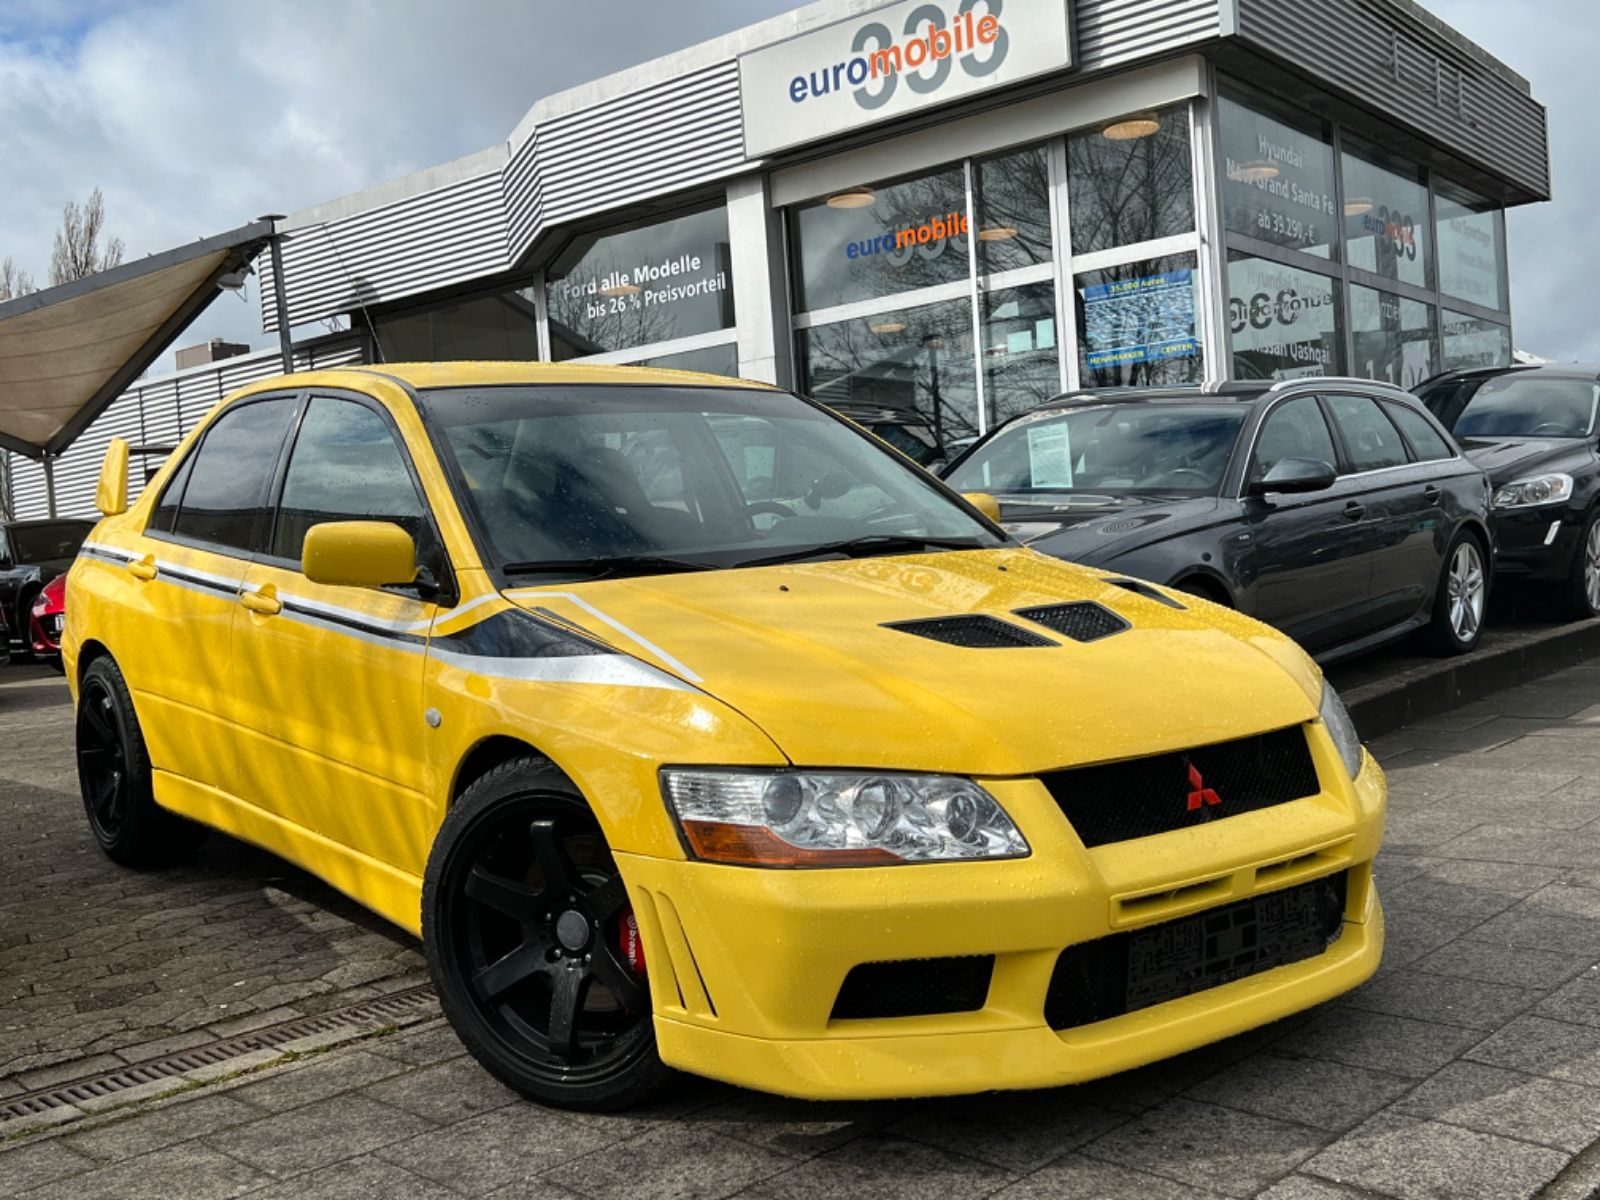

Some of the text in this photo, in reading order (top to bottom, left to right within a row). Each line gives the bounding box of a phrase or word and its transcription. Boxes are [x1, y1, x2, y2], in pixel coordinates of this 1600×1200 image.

[789, 11, 1000, 103] euromobile
[1257, 134, 1303, 168] Hyundai
[1258, 209, 1271, 229] ab
[1291, 182, 1320, 210] Santa
[1322, 194, 1334, 215] Fe
[846, 212, 968, 260] euromobile
[563, 254, 701, 300] Ford alle Modelle
[587, 301, 606, 320] bis
[610, 296, 626, 314] 26
[645, 272, 726, 307] Preisvorteil
[628, 929, 637, 971] bremb
